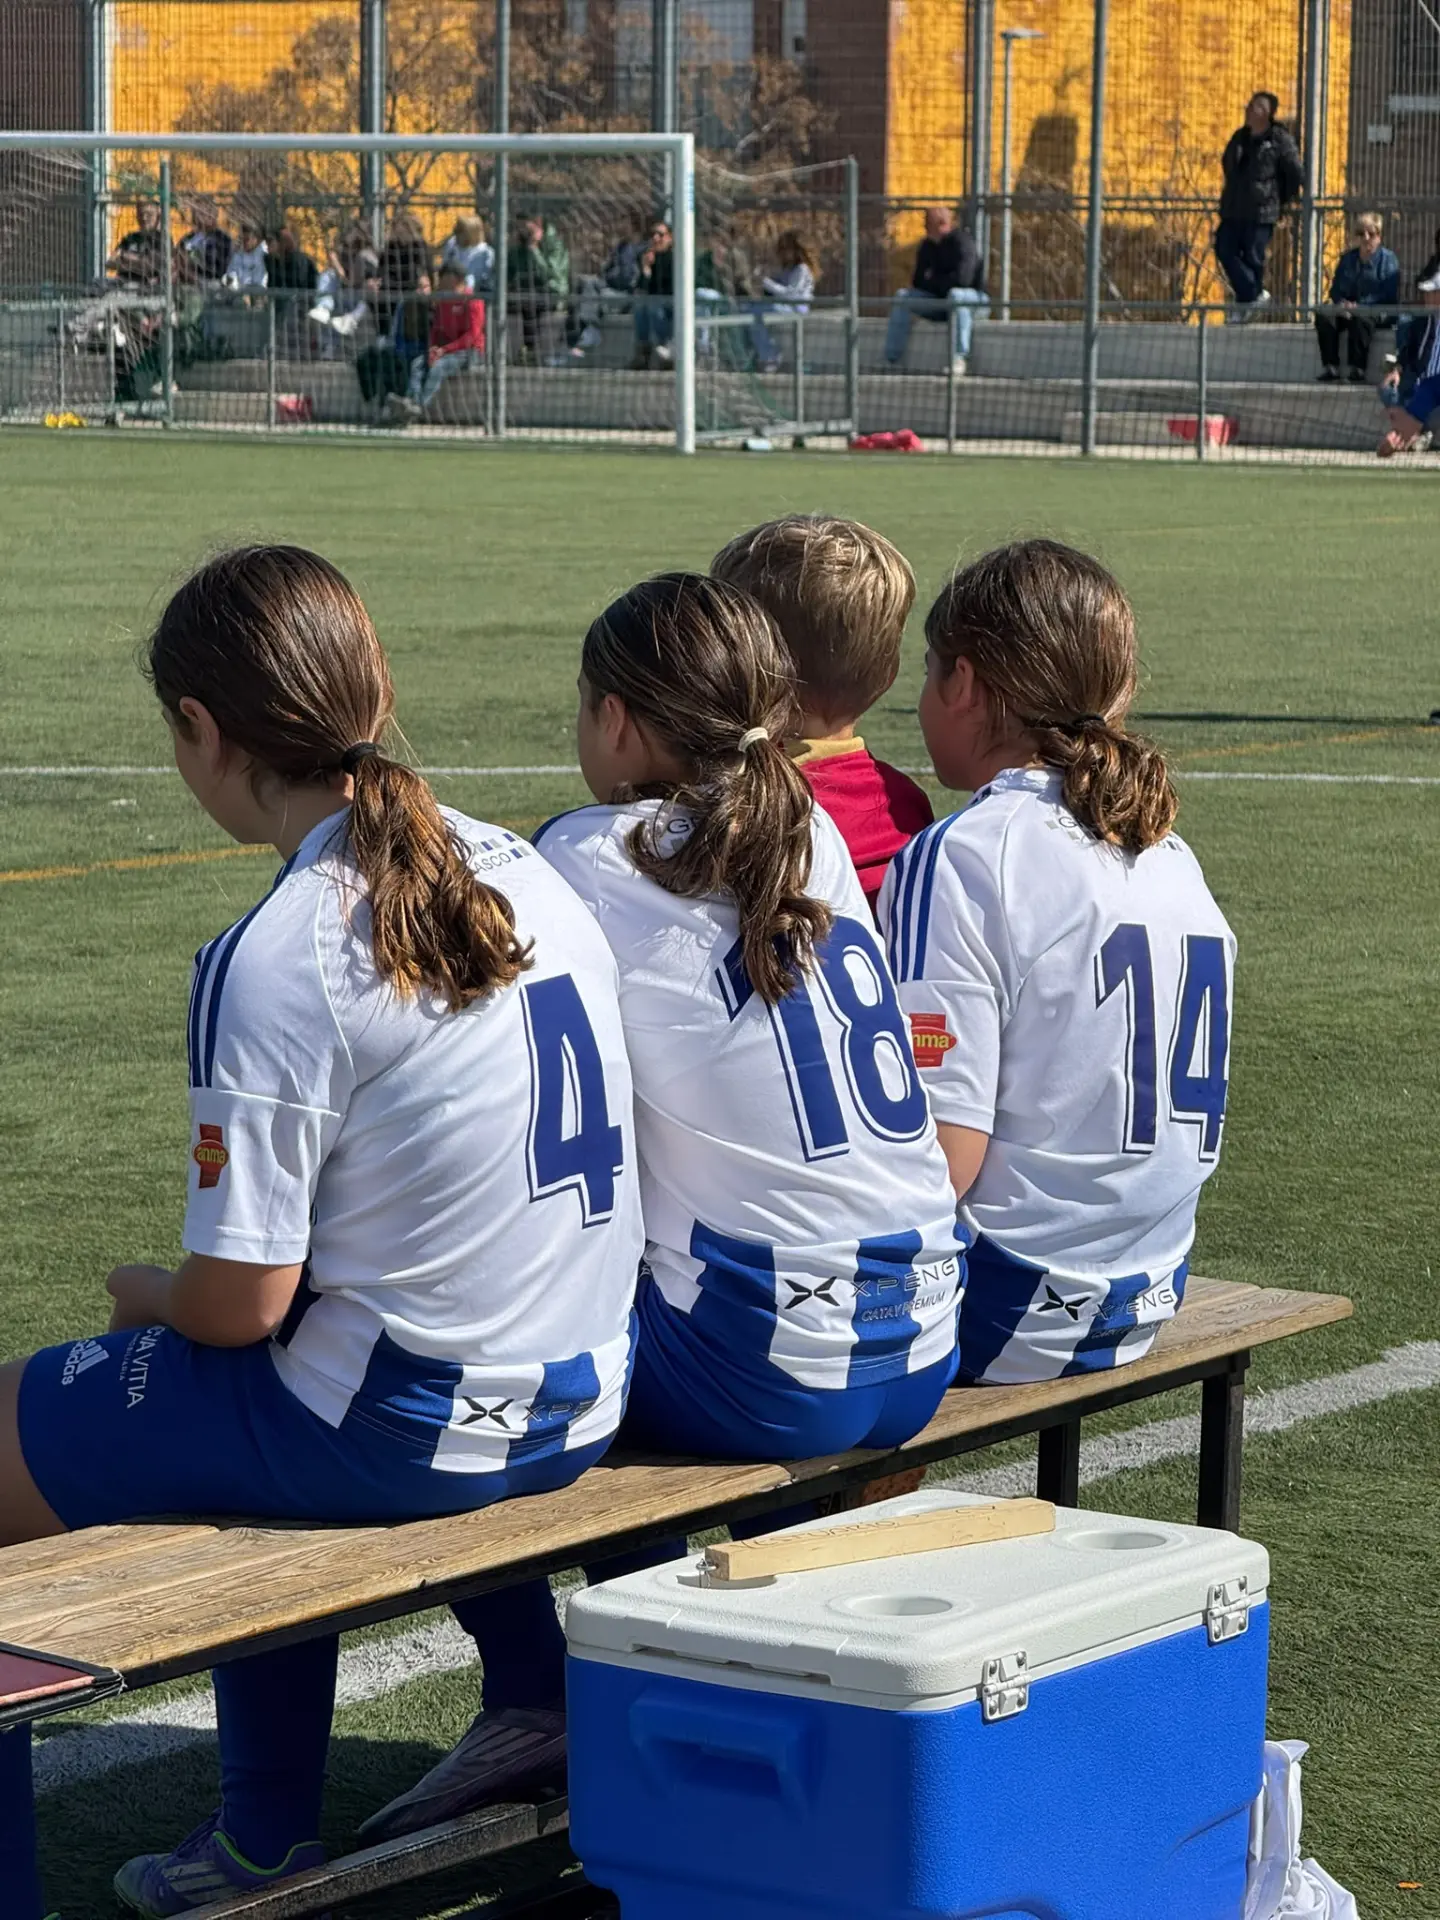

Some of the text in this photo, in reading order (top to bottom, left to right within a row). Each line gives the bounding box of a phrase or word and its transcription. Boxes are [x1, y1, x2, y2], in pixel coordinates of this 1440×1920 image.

[519, 972, 624, 1230] 4
[715, 914, 928, 1163] 18
[1094, 922, 1229, 1164] 14
[850, 1258, 956, 1297] XPENG
[861, 1290, 946, 1322] CATAY PREMIUM
[127, 1352, 153, 1409] VITIA
